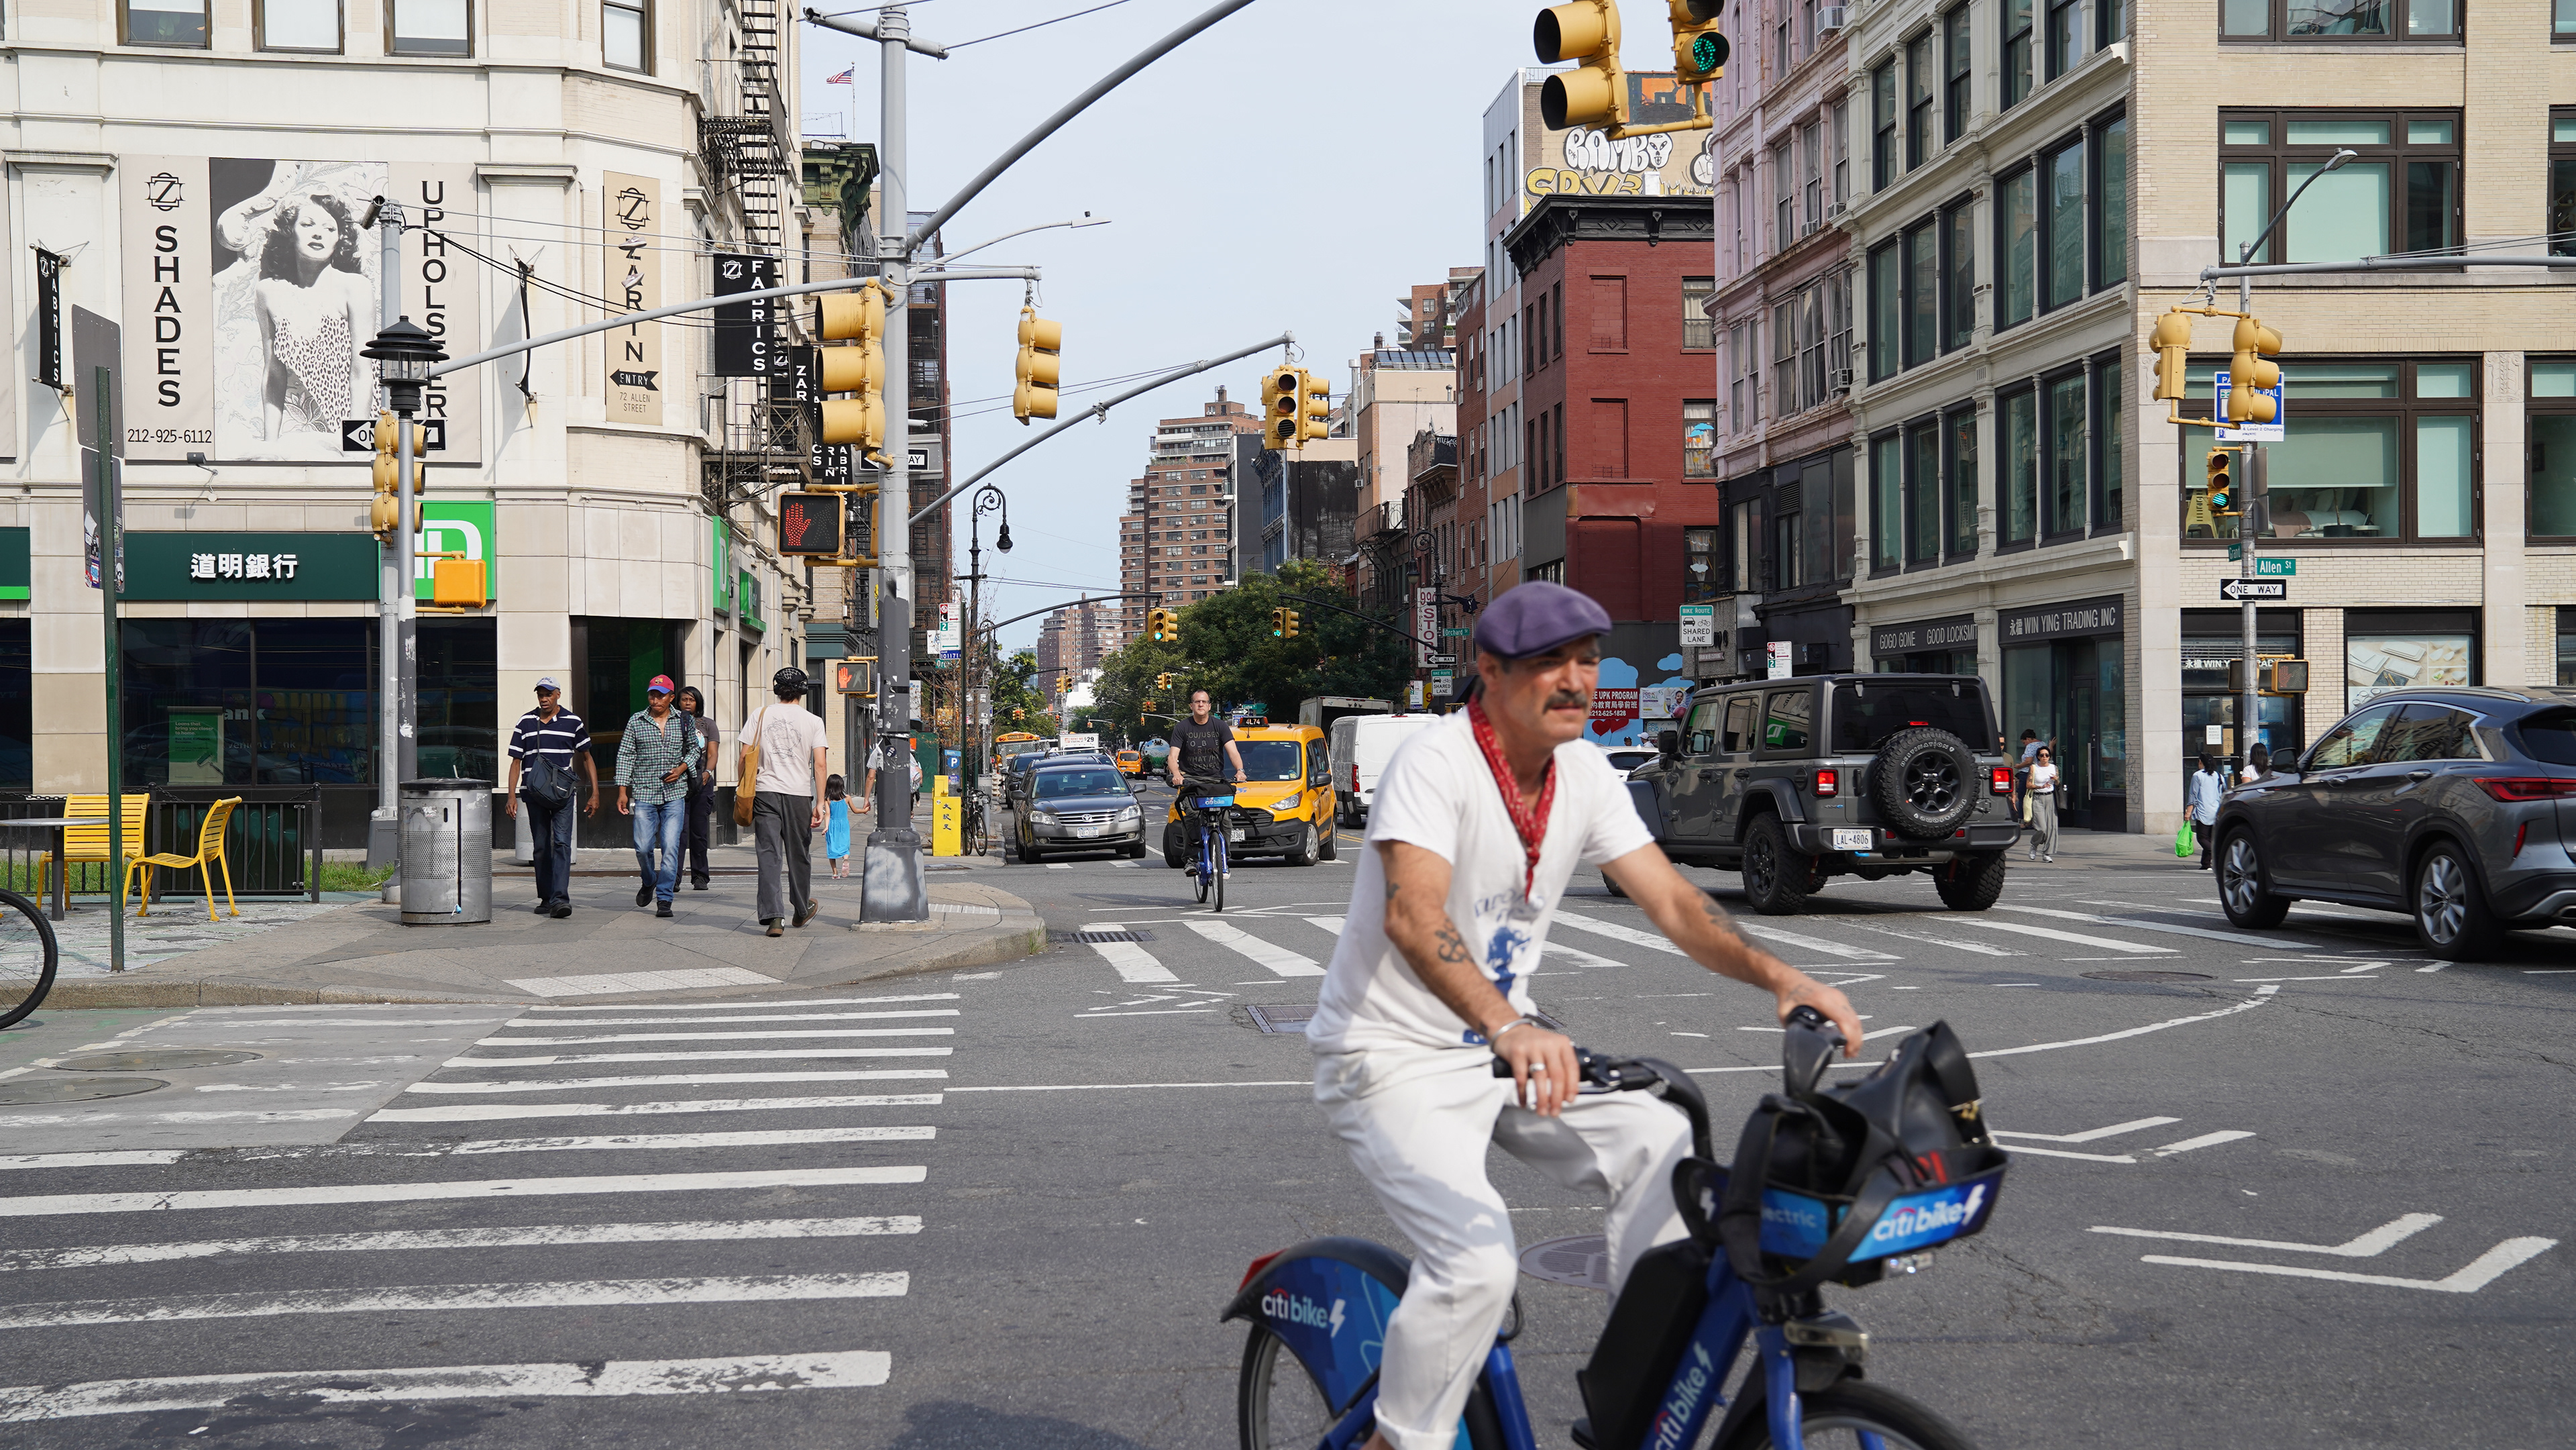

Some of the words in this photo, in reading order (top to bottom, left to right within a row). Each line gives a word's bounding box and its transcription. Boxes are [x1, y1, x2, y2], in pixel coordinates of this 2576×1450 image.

[50, 260, 59, 382] FABRICS
[154, 225, 182, 407] SHADES
[620, 374, 649, 386] ENTRY
[619, 392, 628, 401] 72
[631, 393, 650, 403] ALLEN
[623, 403, 647, 413] STREET
[127, 429, 212, 444] 212-925-6112
[2229, 546, 2241, 560] Grand
[191, 554, 299, 579] 道明銀行
[2259, 560, 2282, 573] Allen
[2230, 585, 2248, 594] ONE
[2257, 585, 2277, 594] WAY
[2024, 617, 2039, 635] WIN
[2041, 613, 2059, 632] YING
[2061, 609, 2098, 631] TRADING
[2100, 607, 2116, 627] INC
[1880, 634, 1897, 650] GOGO
[1898, 631, 1915, 648] GONE
[1927, 628, 1945, 645] GOOD
[1947, 623, 1978, 643] LOCKSMIT
[2203, 660, 2221, 668] WIN
[1611, 691, 1638, 699] PROGRAM
[223, 708, 266, 720] ank
